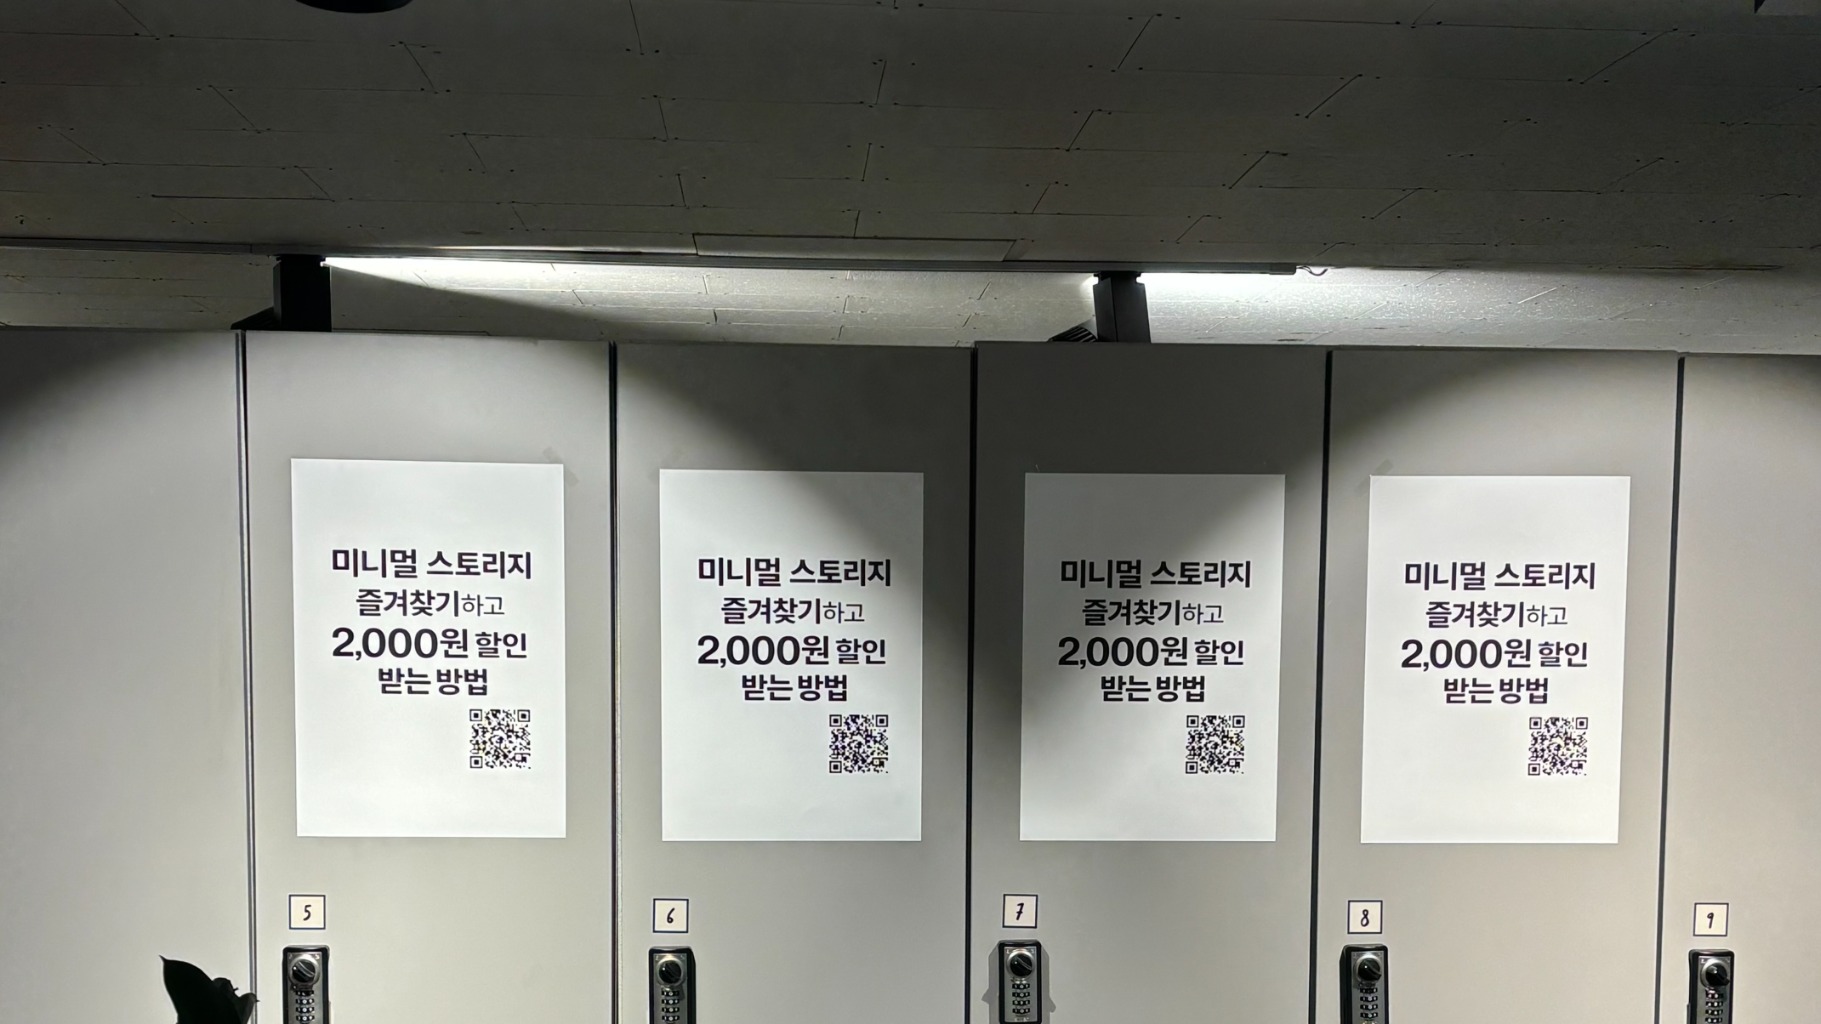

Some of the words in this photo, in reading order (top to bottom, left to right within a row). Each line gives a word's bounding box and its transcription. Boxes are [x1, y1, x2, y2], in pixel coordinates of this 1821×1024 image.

[332, 547, 418, 579] 미니멀
[426, 550, 532, 580] 스토리지
[698, 556, 782, 588] 미니멀
[789, 558, 891, 587] 스토리지
[1060, 559, 1142, 589] 미니멀
[1150, 560, 1251, 589] 스토리지
[1404, 561, 1486, 591] 미니멀
[1493, 562, 1596, 590] 스토리지
[355, 588, 505, 618] 즐겨찾기하고
[720, 596, 865, 625] 즐겨찾기하고
[1082, 598, 1225, 626] 즐겨찾기하고
[1425, 600, 1568, 629] 즐겨찾기하고
[331, 626, 469, 661] 2,000원
[474, 631, 528, 659] 할인
[697, 634, 830, 669] 2,000원
[835, 638, 886, 665] 할인
[1058, 636, 1188, 670] 2,000원
[1194, 639, 1244, 666] 할인
[1401, 638, 1532, 673] 2,000원
[1537, 641, 1588, 668] 할인
[378, 667, 432, 695] 받는
[436, 668, 488, 696] 방법
[741, 673, 794, 702] 받는
[797, 674, 848, 702] 방법
[1100, 675, 1152, 702] 받는
[1156, 675, 1206, 703] 방법
[1443, 677, 1495, 704] 받는
[1499, 677, 1549, 705] 방법
[302, 904, 312, 922] 5
[666, 907, 676, 924] 6
[1015, 902, 1025, 921] 7
[1360, 908, 1370, 928] 8
[1706, 911, 1715, 929] 9
